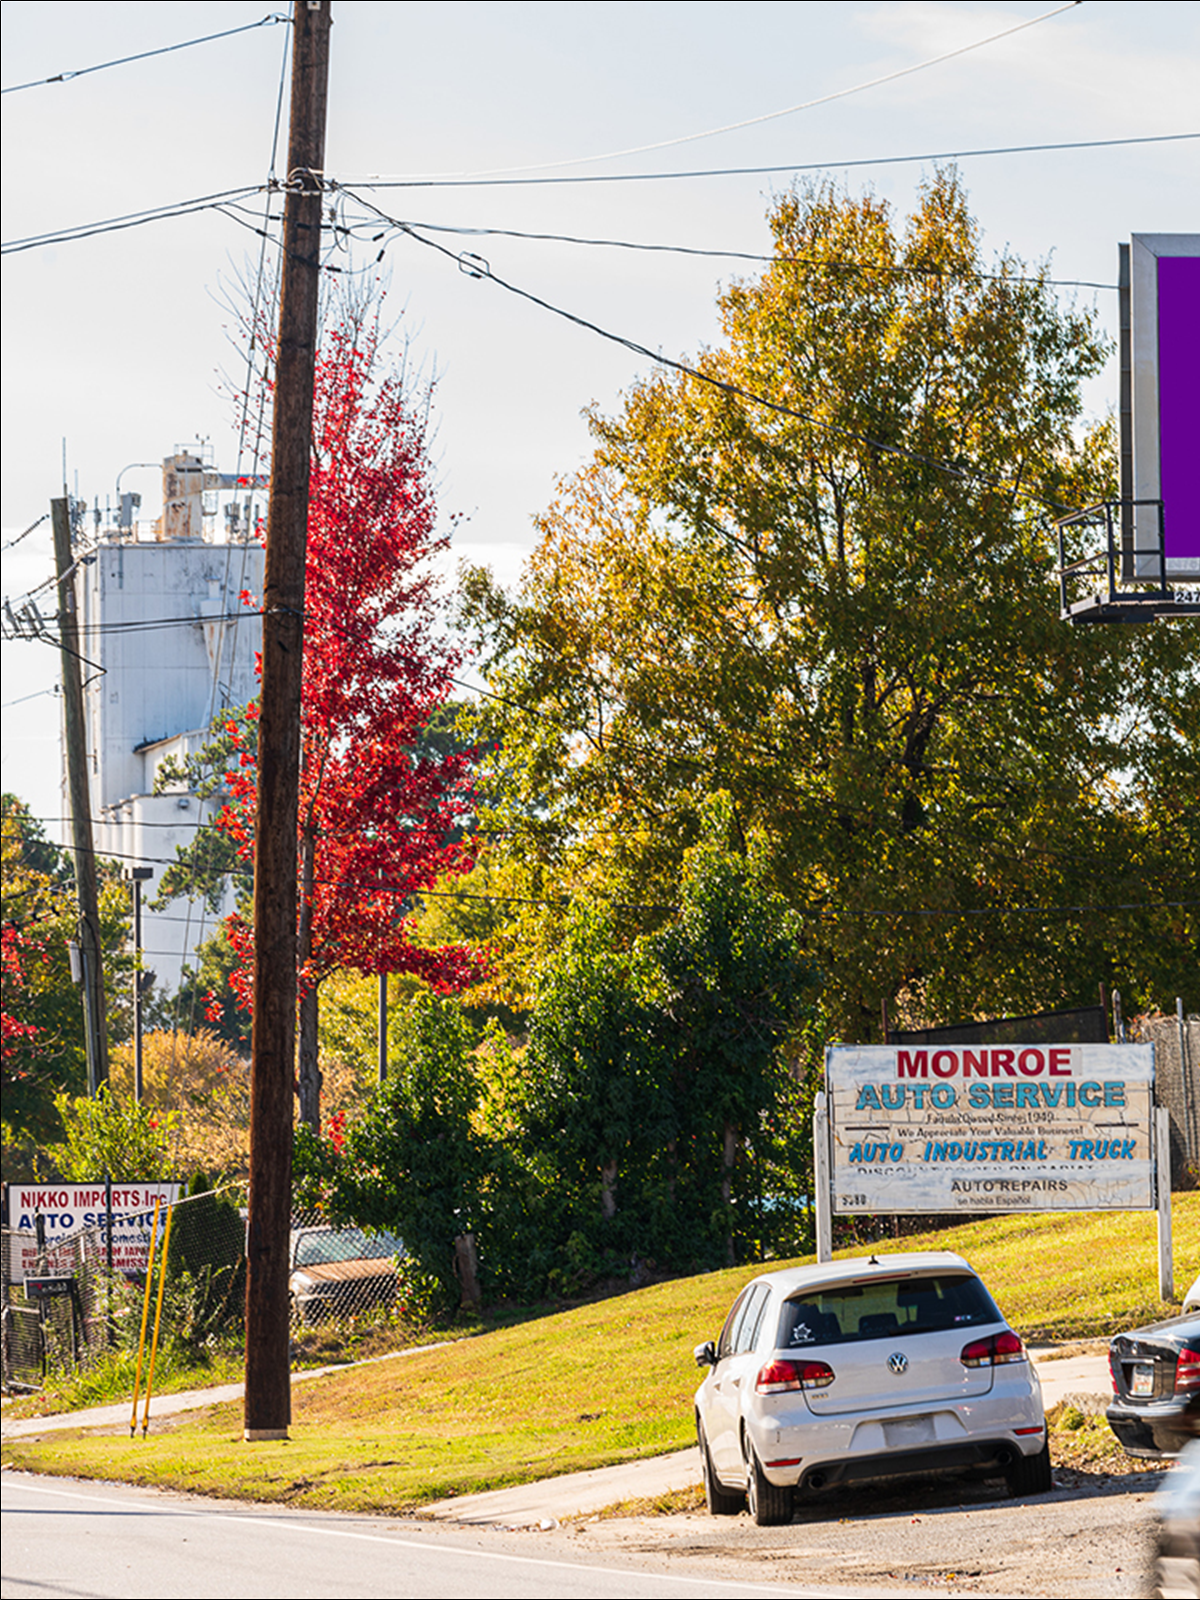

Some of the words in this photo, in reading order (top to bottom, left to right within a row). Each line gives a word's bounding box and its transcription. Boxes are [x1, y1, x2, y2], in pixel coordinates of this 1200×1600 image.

[898, 1049, 1072, 1078] MONROE
[855, 1084, 956, 1110] AUTO
[968, 1081, 1126, 1109] SERVICE
[898, 1128, 914, 1137] We
[969, 1127, 991, 1136] Your
[994, 1126, 1035, 1136] Valuable
[849, 1142, 904, 1163] AUTO
[923, 1140, 1047, 1162] INDUSTRIAL
[1068, 1139, 1136, 1161] TRUCK
[951, 1181, 994, 1192] AUTO
[1000, 1180, 1068, 1191] REPAIRS
[20, 1191, 69, 1208] NIKKO
